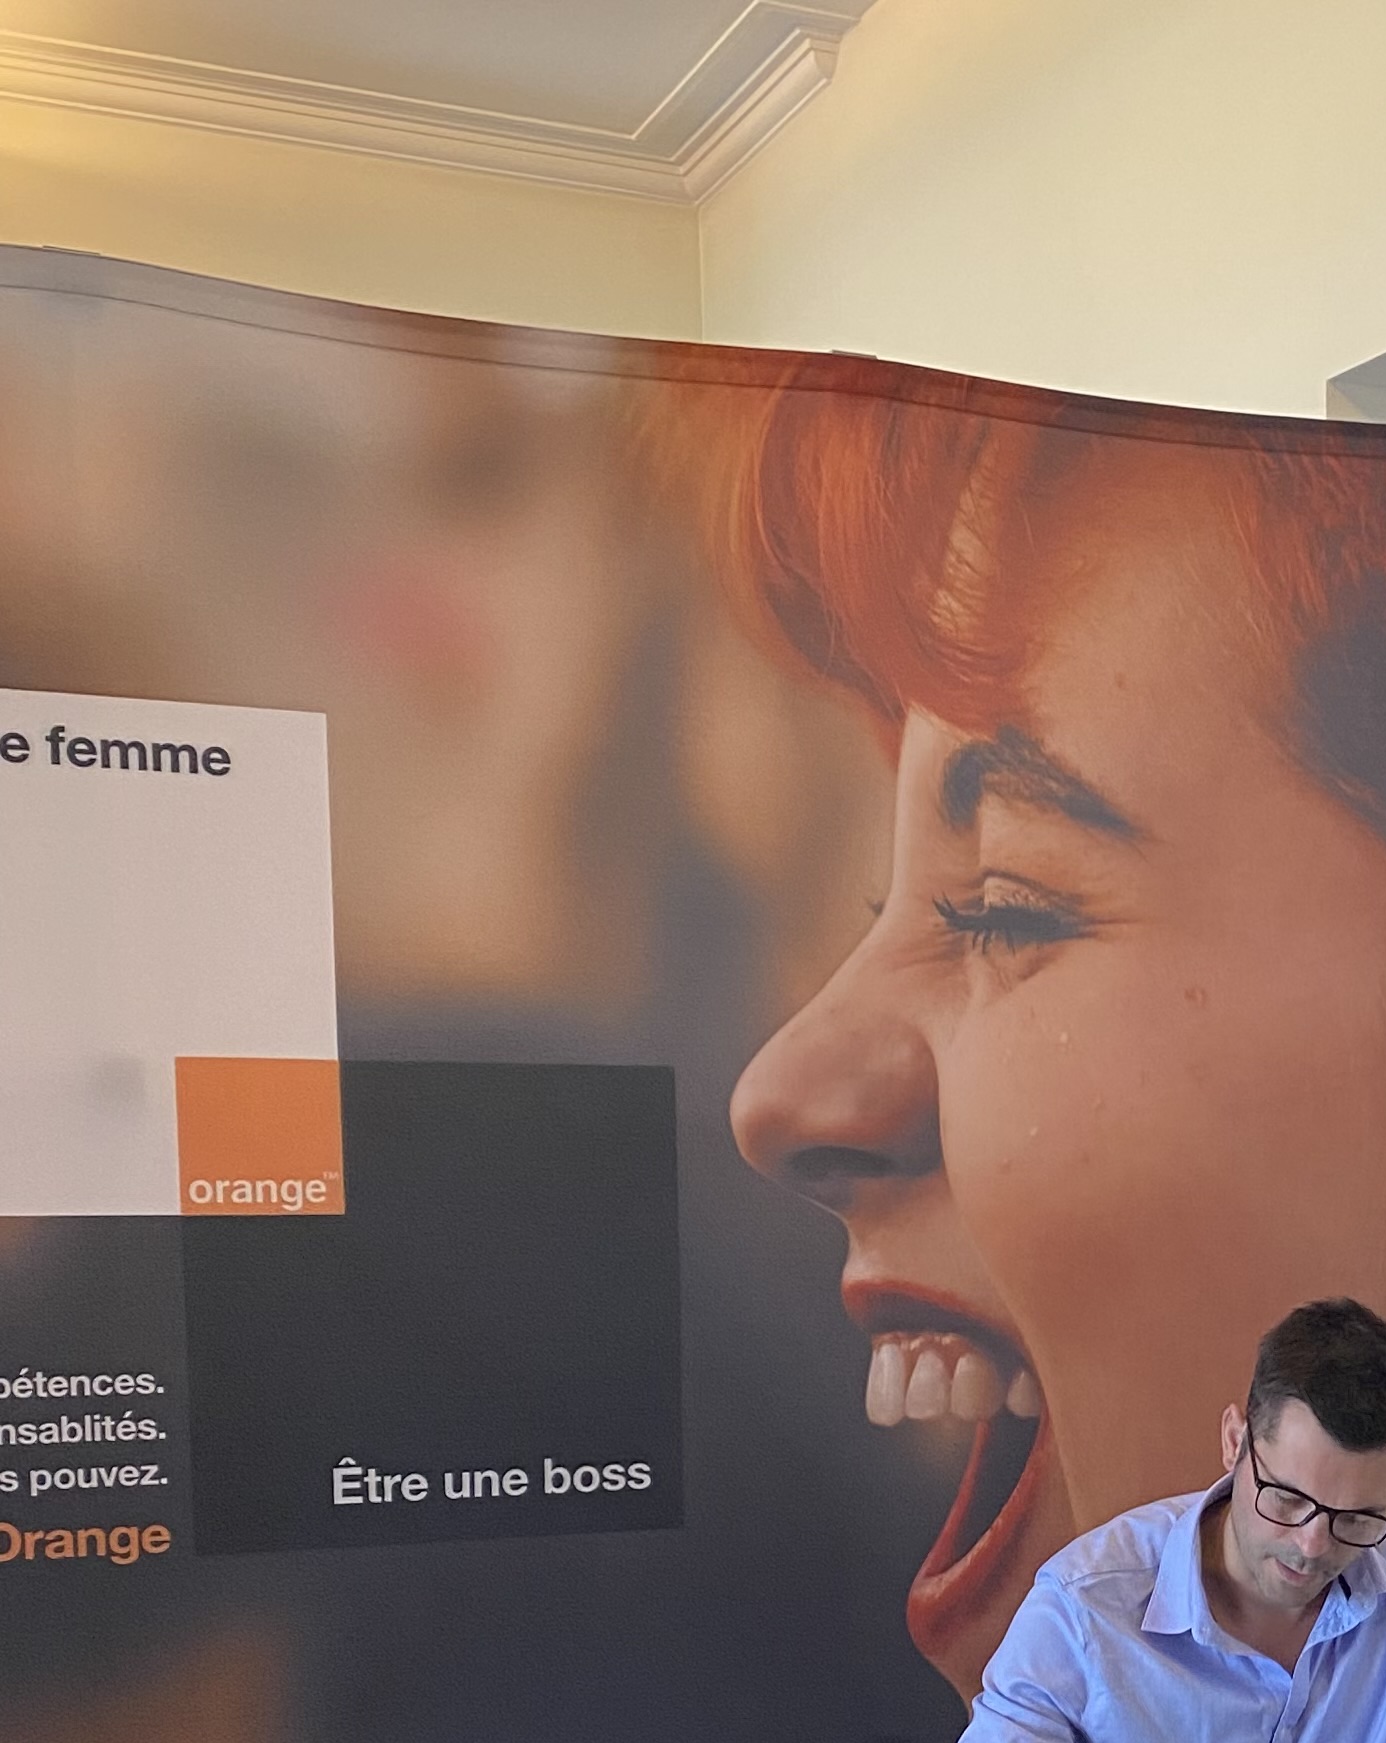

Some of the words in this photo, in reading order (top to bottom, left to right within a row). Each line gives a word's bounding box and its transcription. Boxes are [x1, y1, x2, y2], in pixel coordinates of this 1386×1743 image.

[45, 725, 231, 776] femme
[188, 1179, 327, 1211] orange
[0, 1410, 166, 1446] nsablités.
[30, 1464, 168, 1497] pouvez.
[333, 1456, 429, 1505] Être
[444, 1467, 529, 1500] une
[543, 1457, 652, 1495] boss
[0, 1522, 171, 1565] Orange
